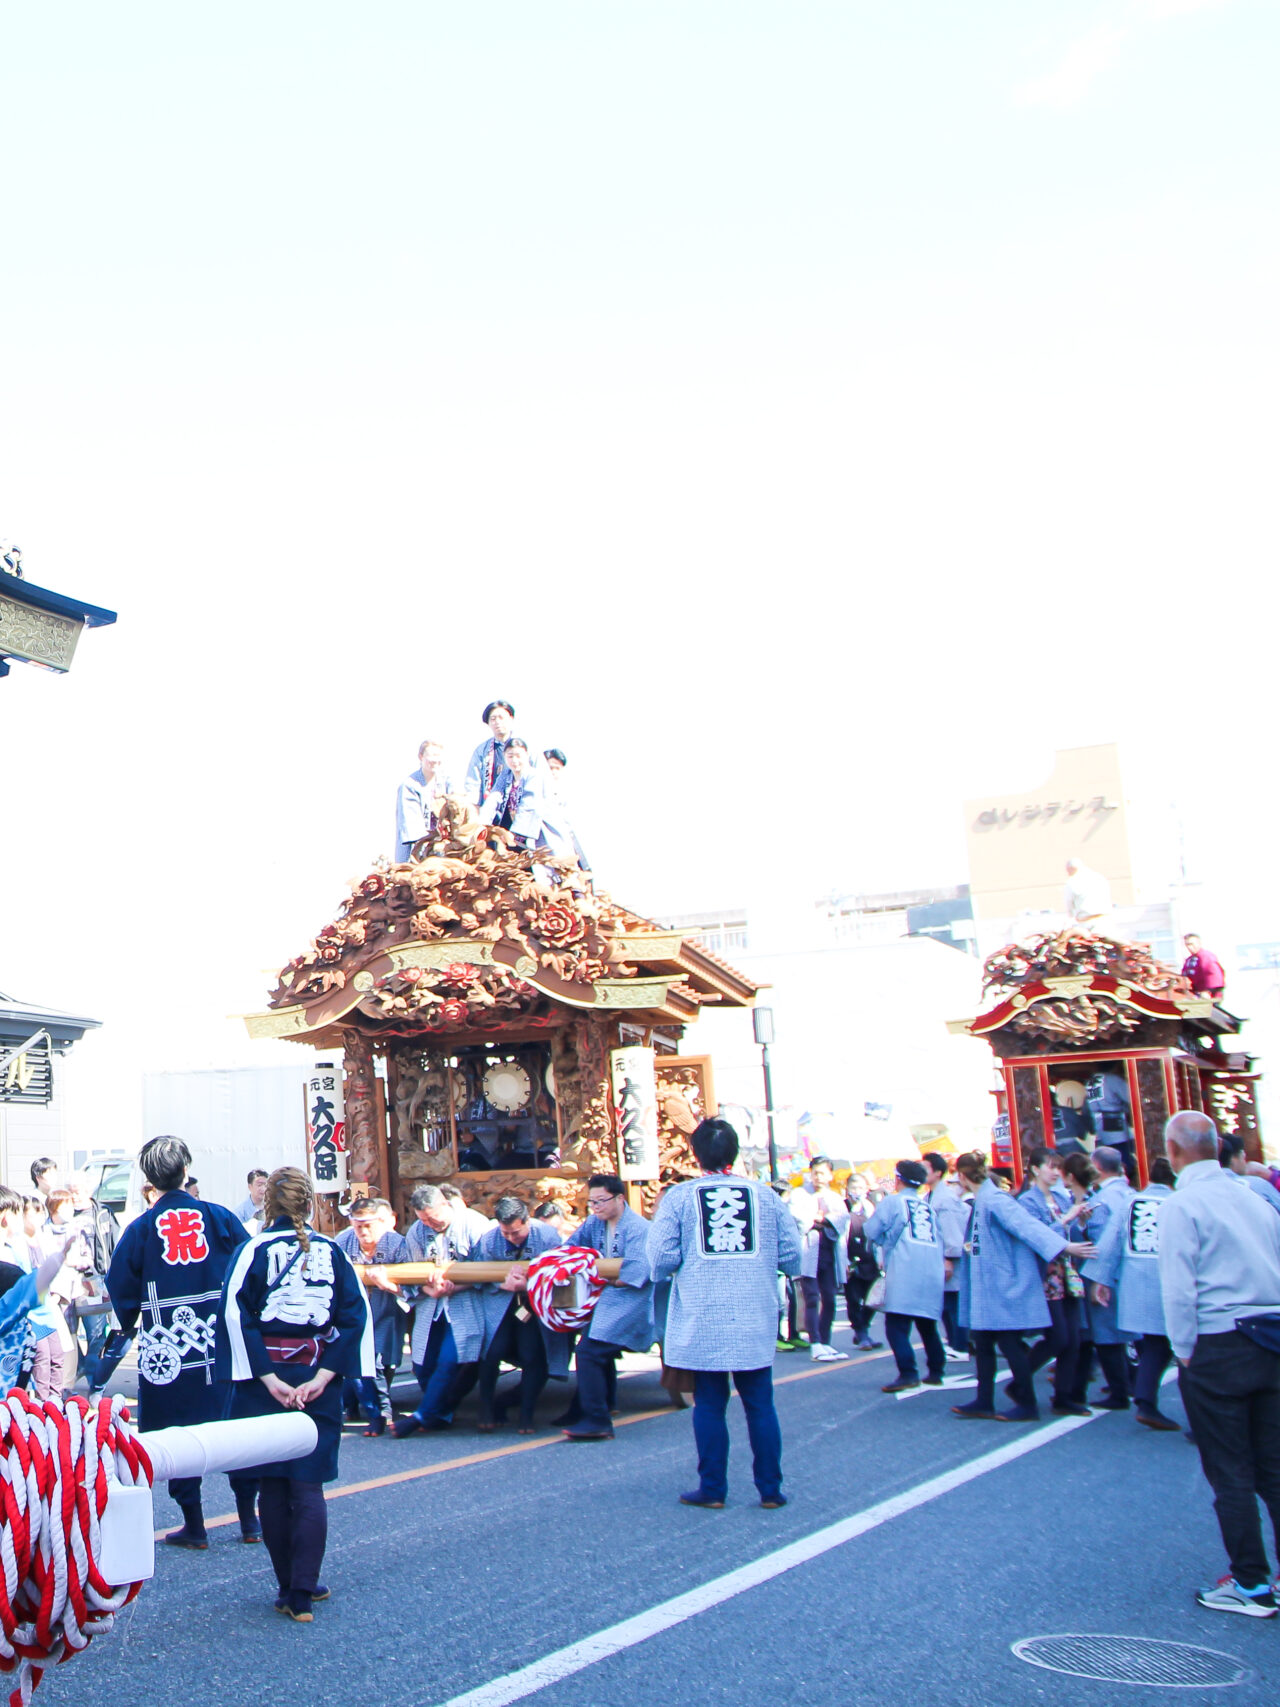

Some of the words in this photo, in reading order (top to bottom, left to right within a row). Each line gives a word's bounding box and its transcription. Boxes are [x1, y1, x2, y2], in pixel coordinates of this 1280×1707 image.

[311, 1096, 338, 1181] 大久保
[619, 1077, 645, 1166] 大久保
[156, 1209, 209, 1264] 荒
[706, 1187, 747, 1252] 大久保
